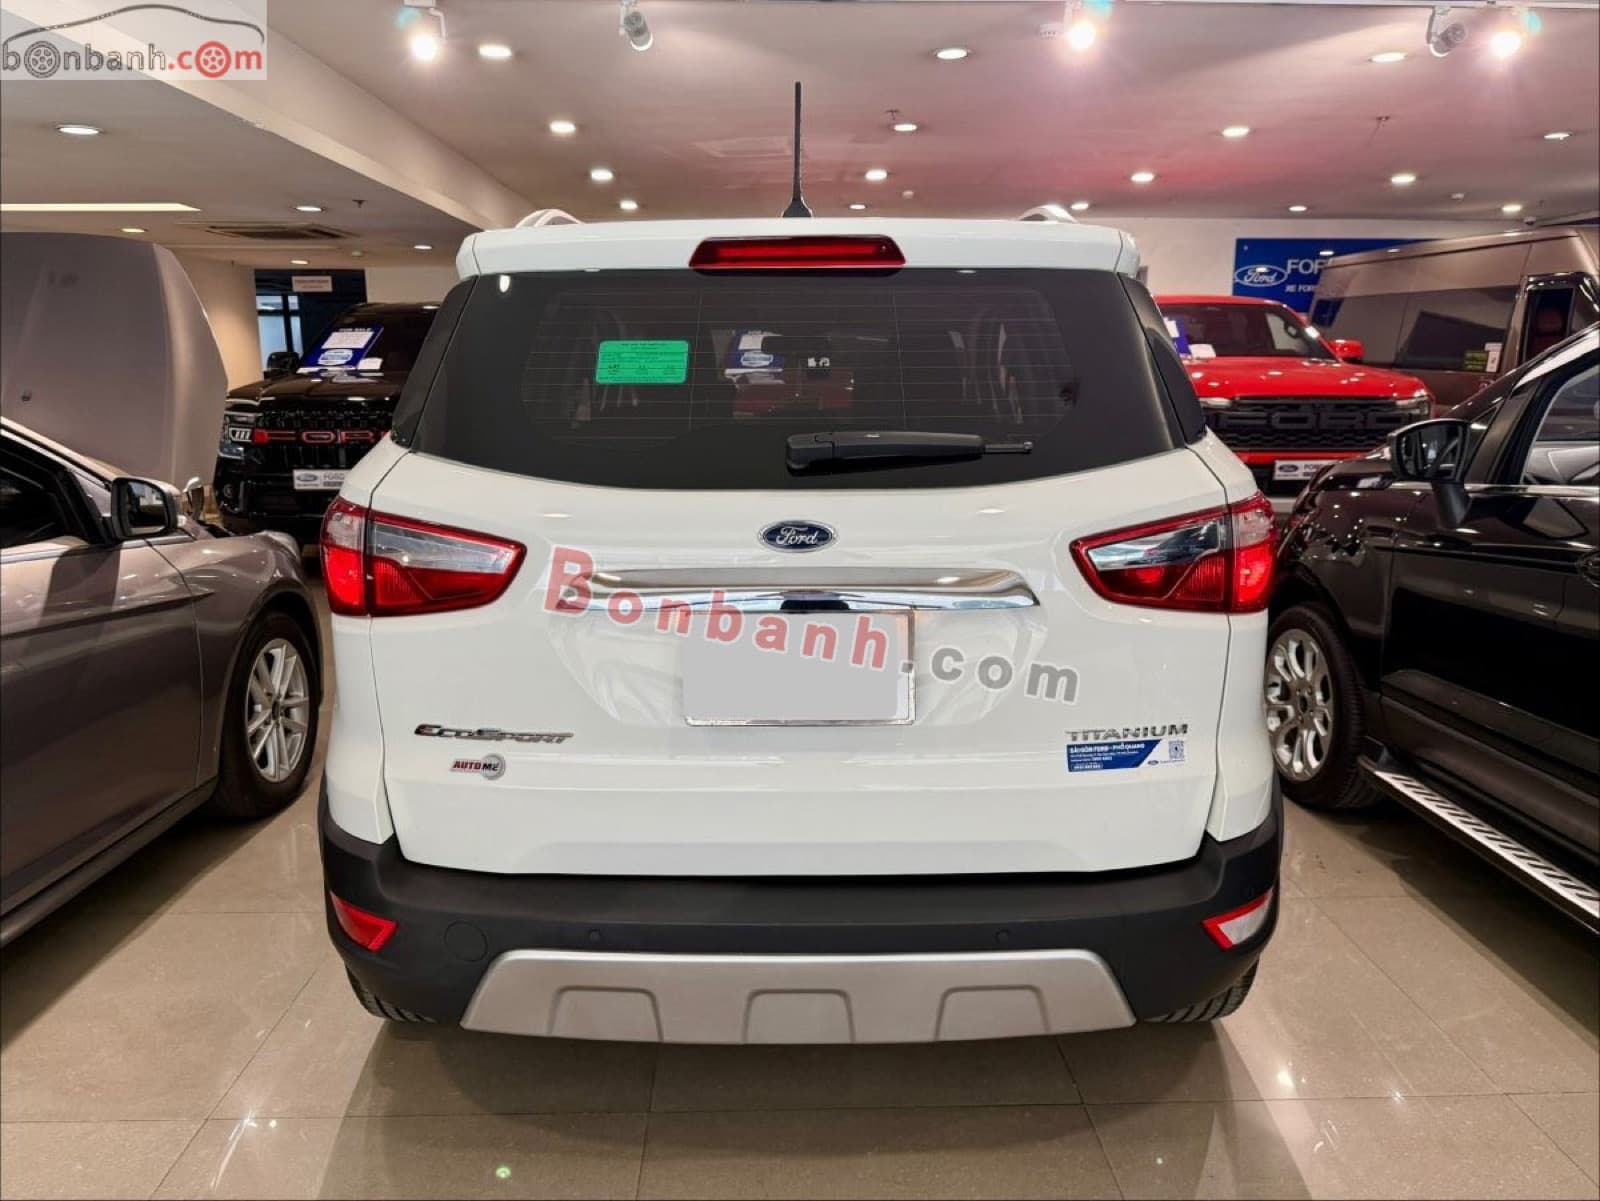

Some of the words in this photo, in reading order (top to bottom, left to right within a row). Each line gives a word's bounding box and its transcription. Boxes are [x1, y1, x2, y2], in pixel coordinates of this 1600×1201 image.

[254, 429, 389, 444] FOR
[775, 526, 819, 545] Ford
[1064, 723, 1189, 741] TITANIUM
